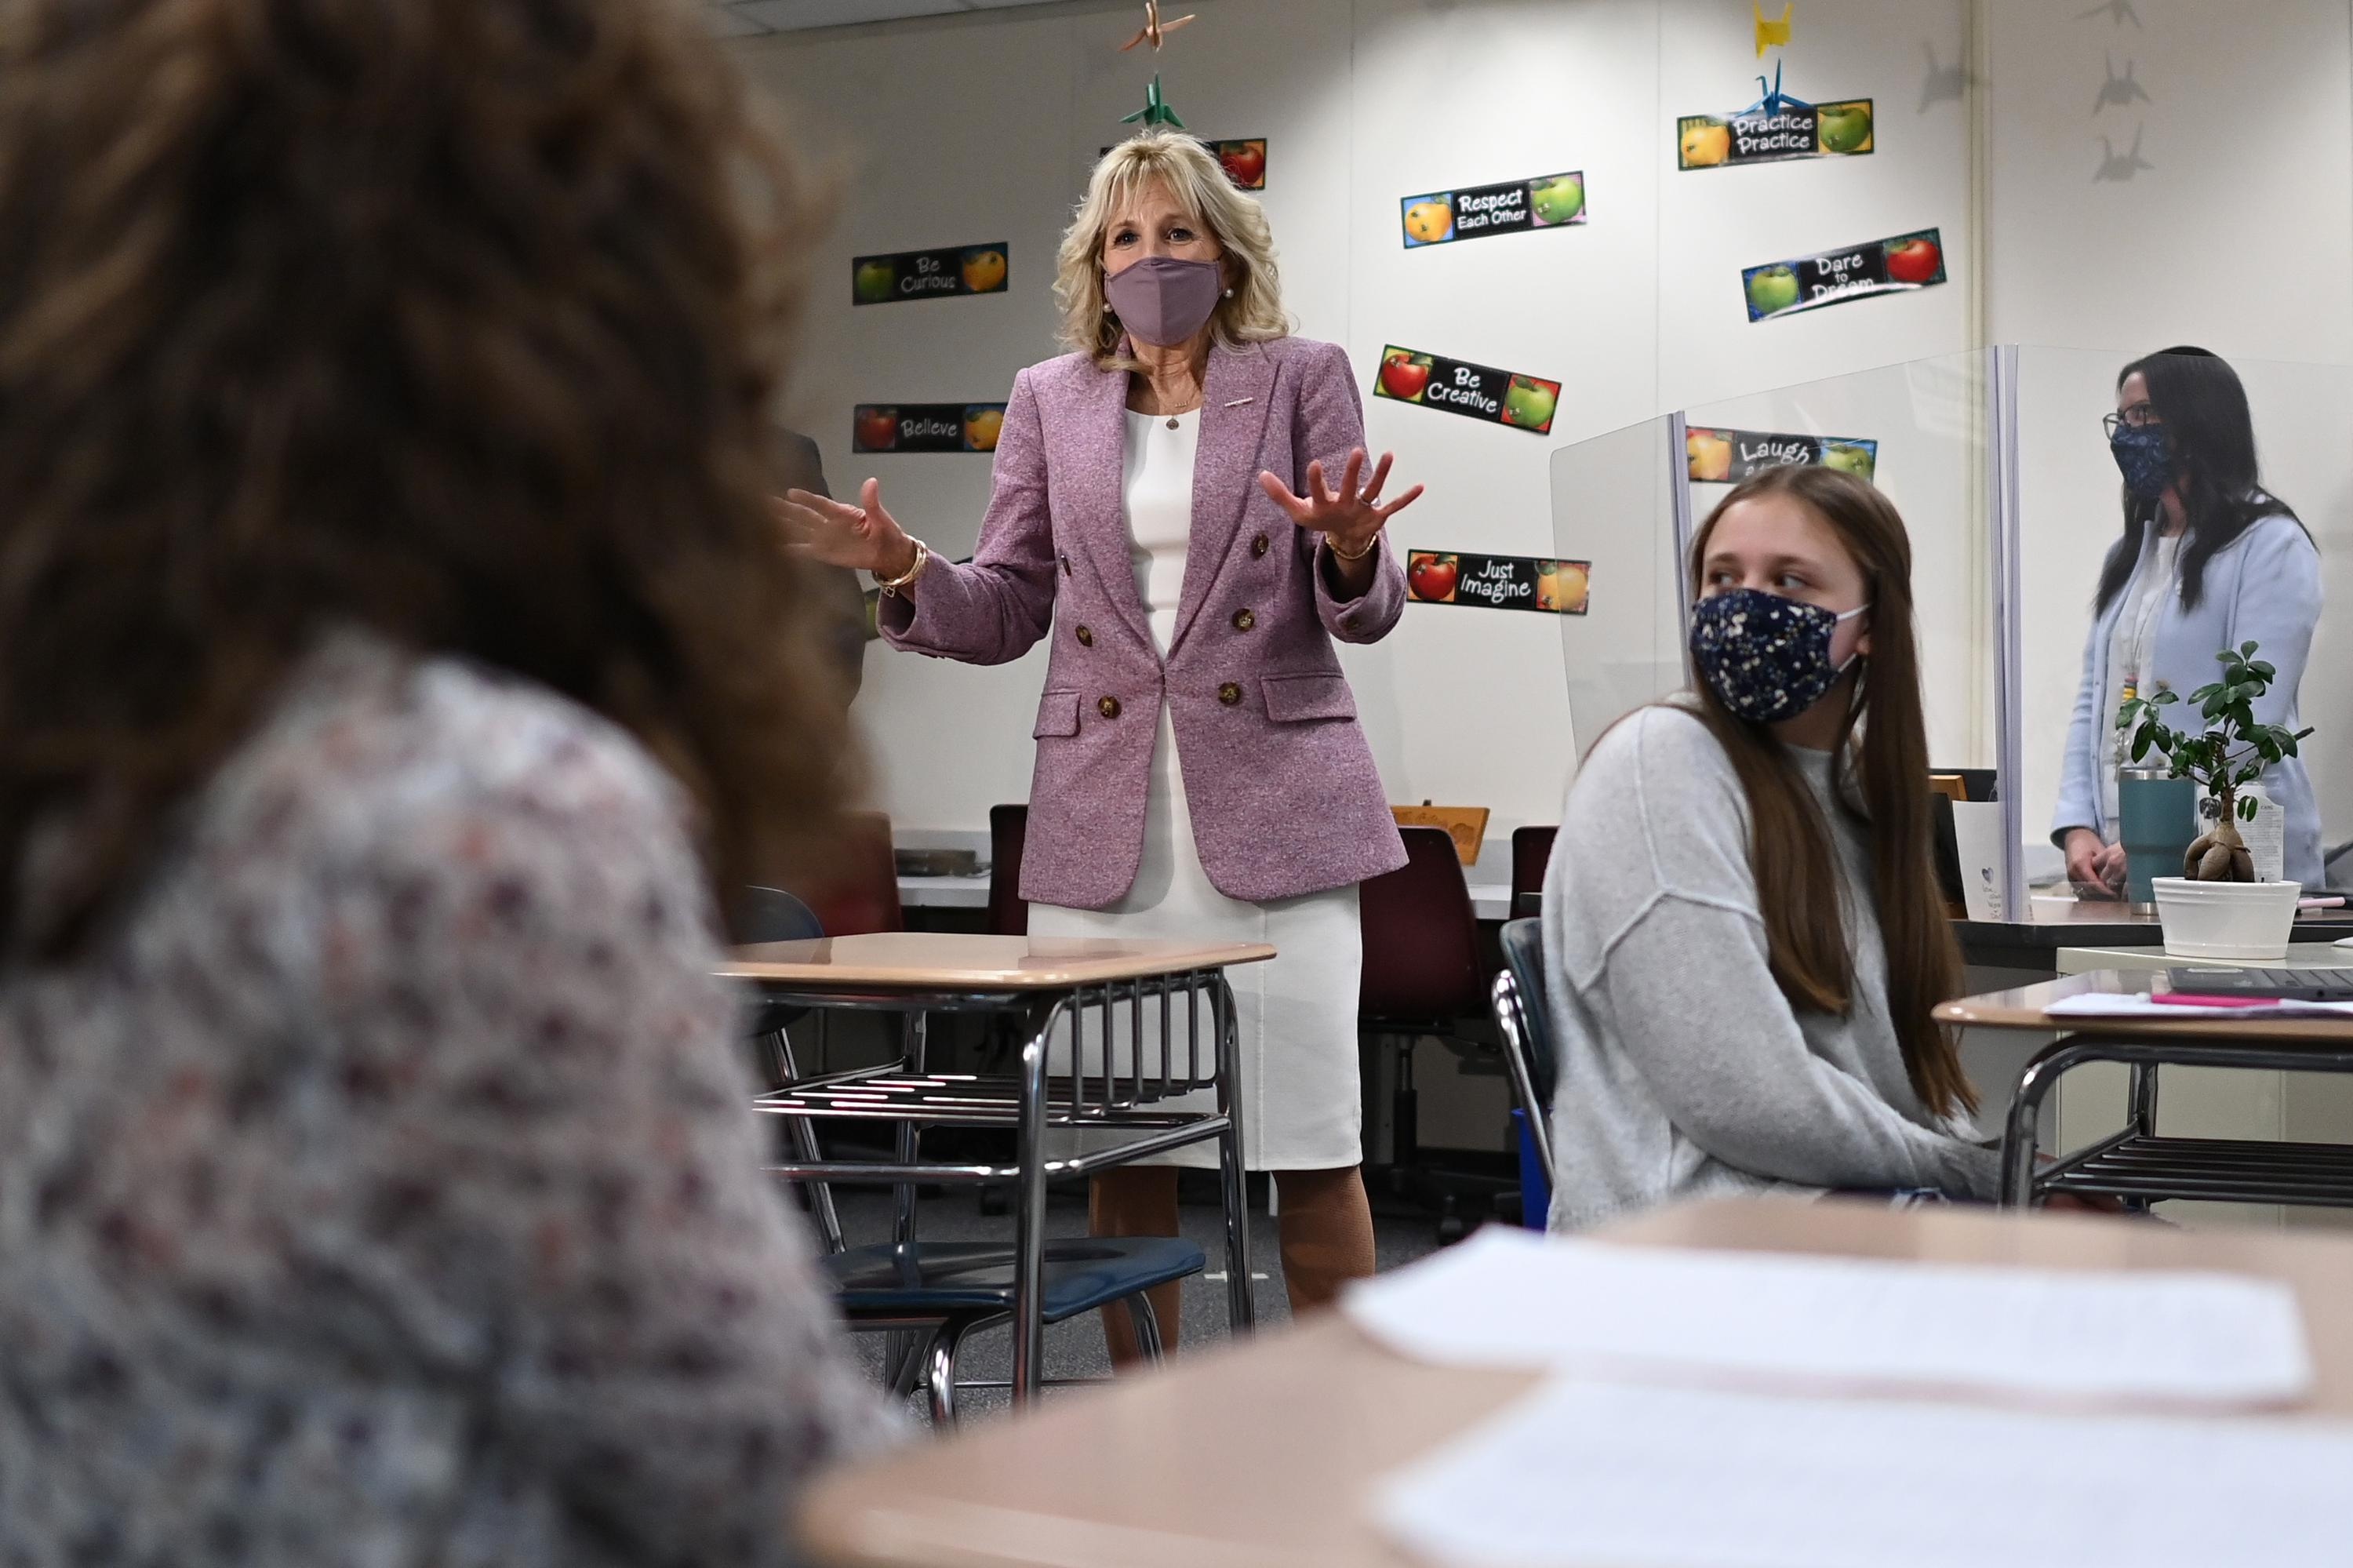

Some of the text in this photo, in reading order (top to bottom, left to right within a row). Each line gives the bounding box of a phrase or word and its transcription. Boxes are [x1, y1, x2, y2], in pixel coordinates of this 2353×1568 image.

[1733, 115, 1813, 136] Practice
[1737, 133, 1810, 154] Practice
[1458, 189, 1522, 212] Respect
[1457, 209, 1526, 229] Each Other
[916, 257, 940, 273] Be
[1816, 254, 1863, 275] Dare
[901, 275, 955, 292] Curious
[1835, 273, 1848, 282] to
[1454, 367, 1480, 387] Be
[1427, 383, 1497, 413] Creative
[900, 418, 957, 437] Believe
[1740, 442, 1809, 464] Laugh
[1478, 560, 1514, 579] Just
[1460, 573, 1531, 603] Imagine
